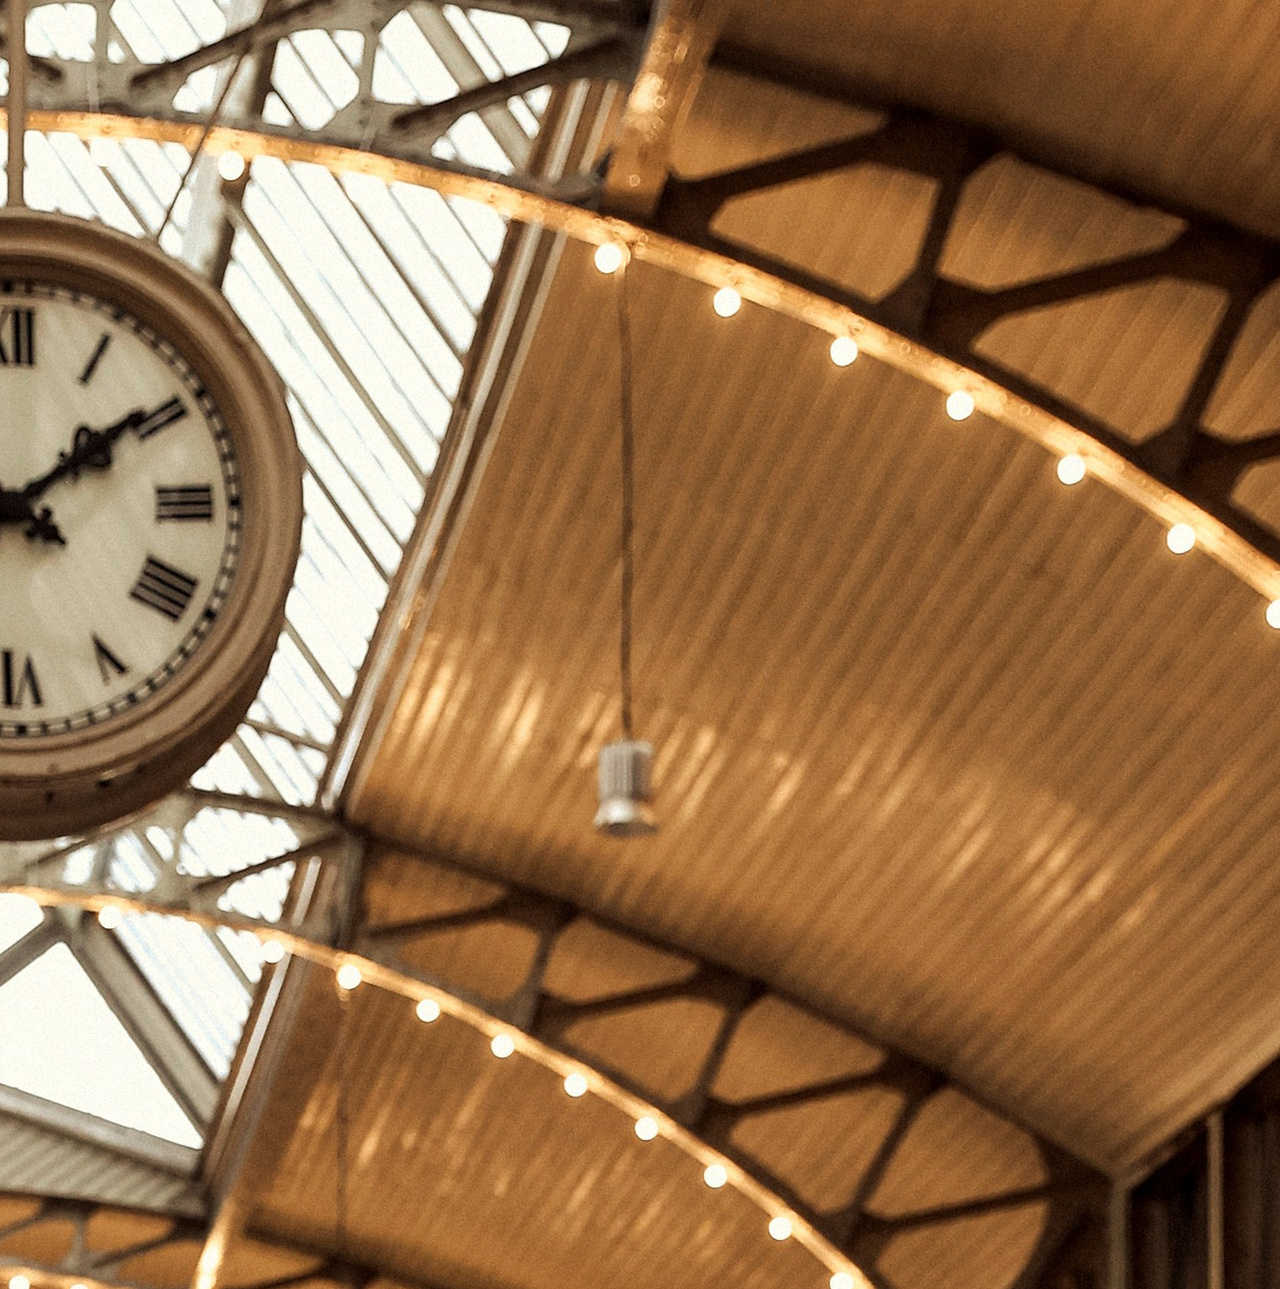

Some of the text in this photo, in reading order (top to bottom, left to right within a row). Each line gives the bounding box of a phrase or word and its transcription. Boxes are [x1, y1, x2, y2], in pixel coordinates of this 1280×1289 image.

[80, 333, 113, 384] I
[155, 484, 214, 522] III
[130, 556, 199, 623] IIII
[1, 647, 44, 708] VI
[92, 633, 128, 685] V
